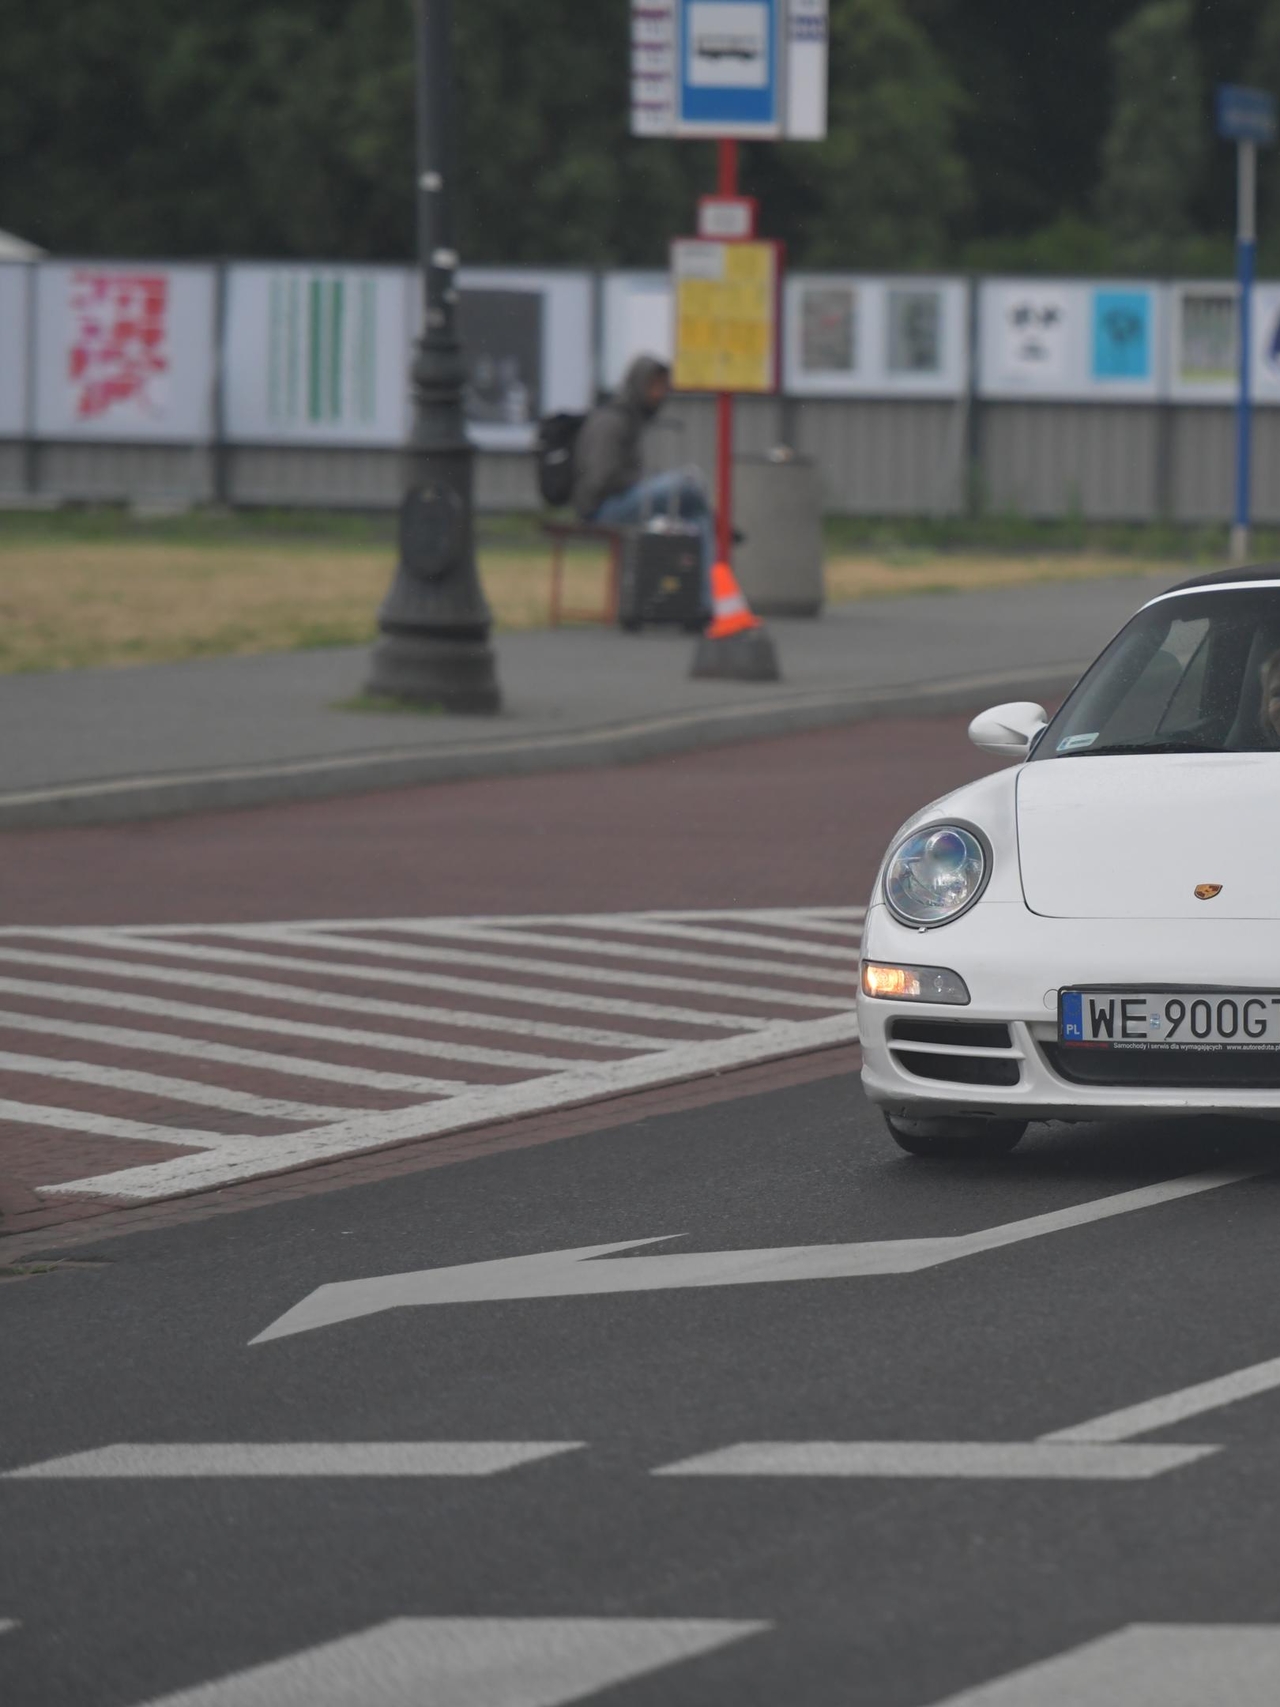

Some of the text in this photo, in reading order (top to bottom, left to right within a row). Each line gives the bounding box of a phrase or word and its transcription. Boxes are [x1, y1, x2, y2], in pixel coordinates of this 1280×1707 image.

[1089, 998, 1147, 1038] WE
[1066, 1024, 1080, 1035] PL
[1113, 1042, 1147, 1050] Samochody
[1180, 1043, 1222, 1051] wymagających
[1226, 1043, 1280, 1051] www.autoreduta.pl
